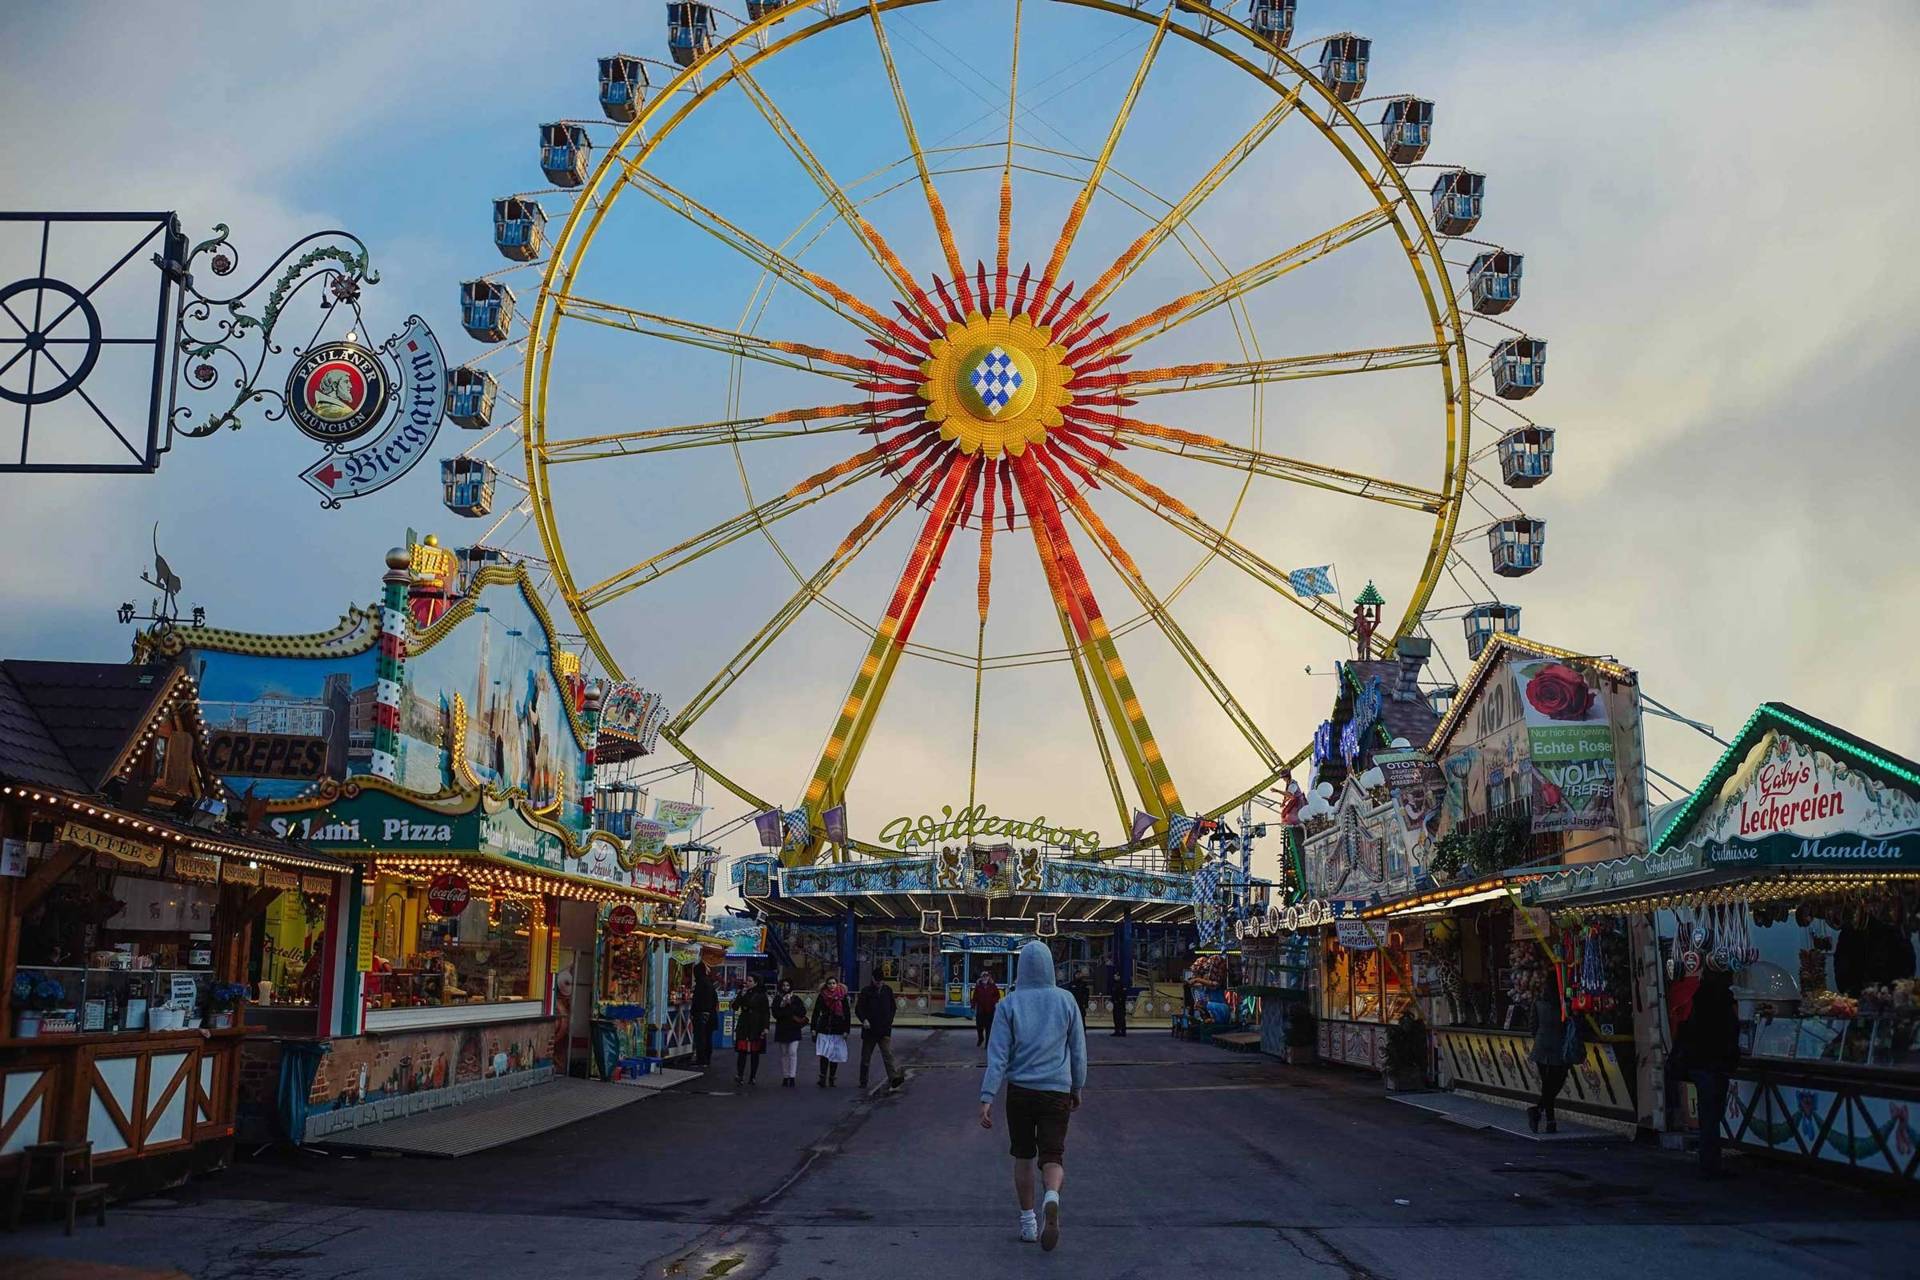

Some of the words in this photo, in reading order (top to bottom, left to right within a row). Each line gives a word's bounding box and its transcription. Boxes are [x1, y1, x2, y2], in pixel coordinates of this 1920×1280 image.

[300, 349, 377, 383] PAULANER
[344, 351, 437, 486] Biergarten
[1477, 683, 1504, 740] JAGD
[1533, 741, 1575, 755] Echte
[1759, 760, 1811, 806] Gaby's
[1740, 783, 1844, 836] Leckereien
[68, 825, 142, 858] KAFFEE
[270, 817, 361, 842] Slami
[382, 817, 452, 842] Pizza
[878, 803, 1101, 857] Willenborg
[1711, 842, 1759, 862] Erdnüsse
[1791, 839, 1904, 860] Mandeln
[967, 936, 1009, 948] KASSE
